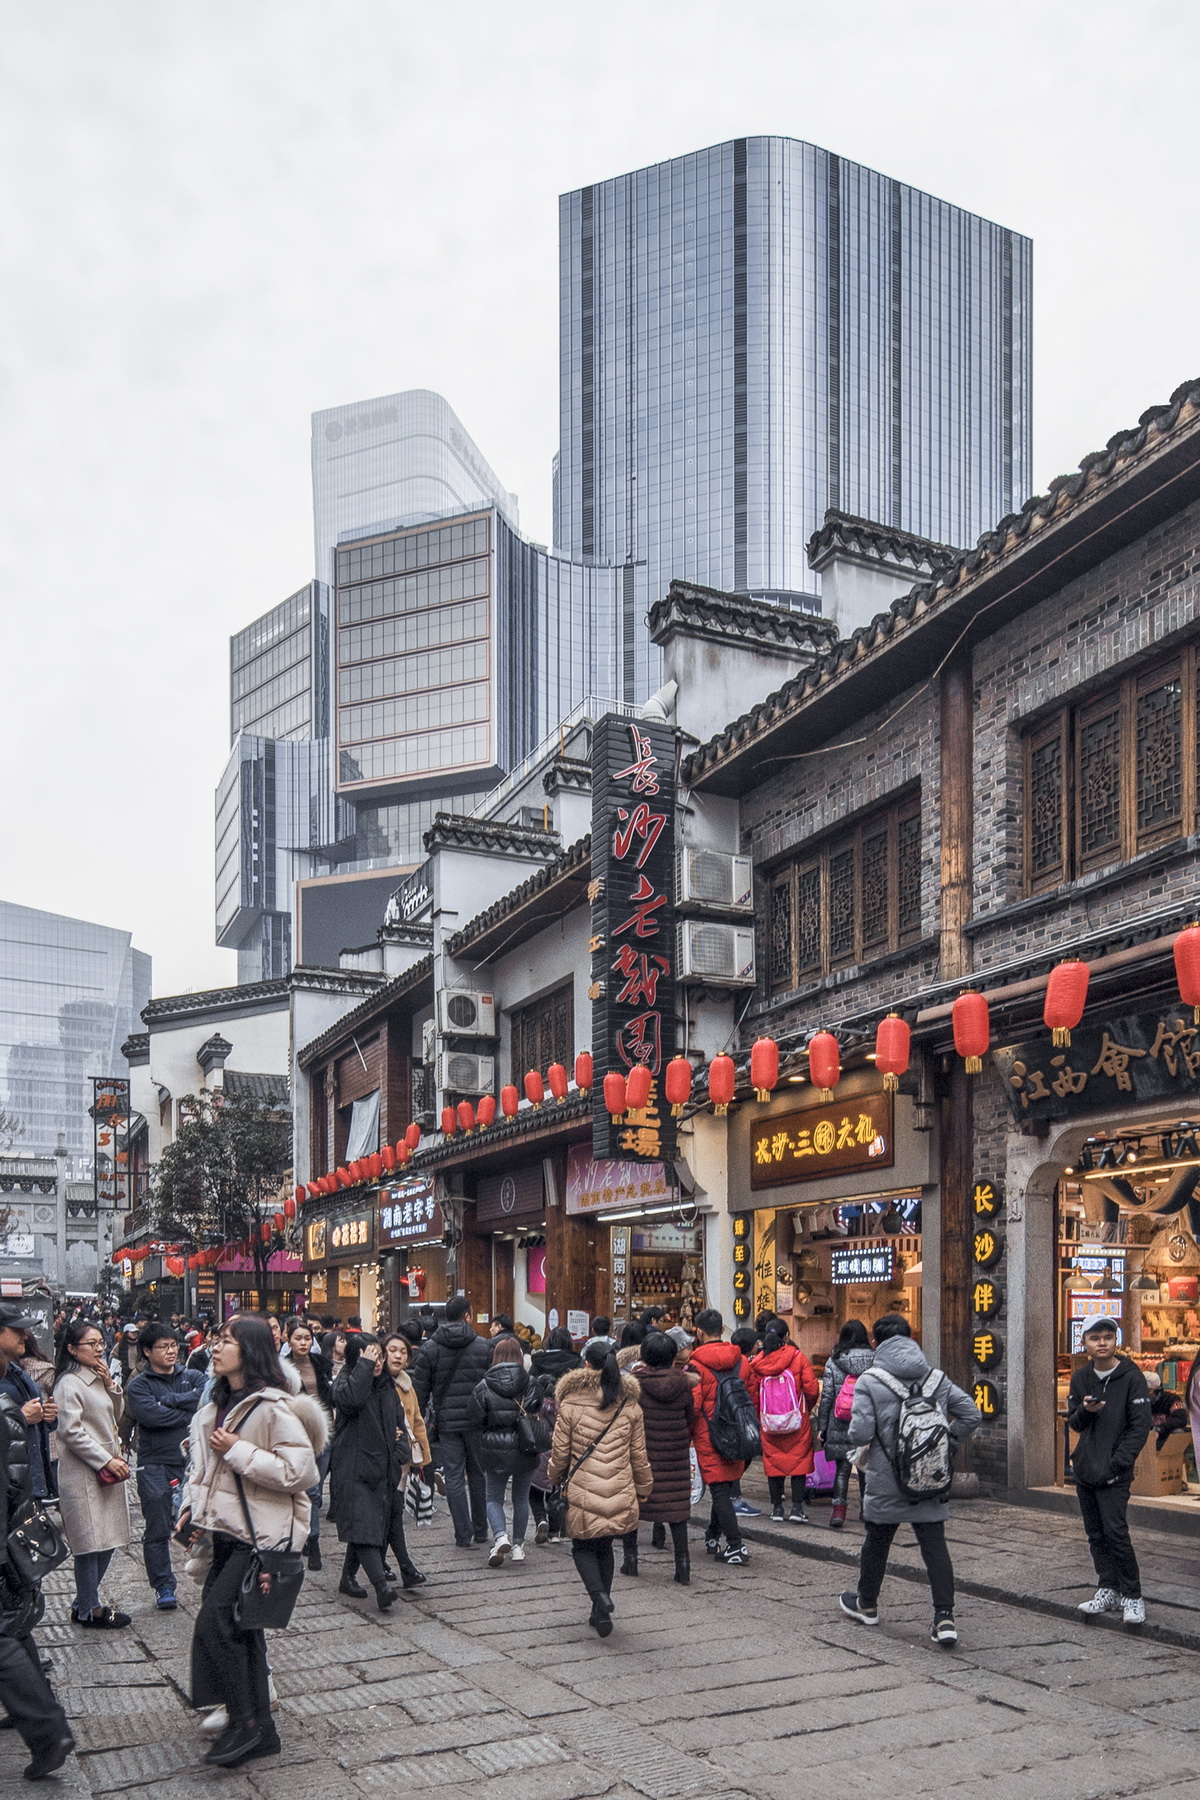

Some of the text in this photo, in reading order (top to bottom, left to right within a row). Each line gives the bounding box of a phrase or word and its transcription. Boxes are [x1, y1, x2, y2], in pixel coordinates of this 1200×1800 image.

[621, 1077, 663, 1158] 工場
[382, 1194, 436, 1229] 湖南老字号
[973, 1184, 994, 1414] 长沙伴手礼
